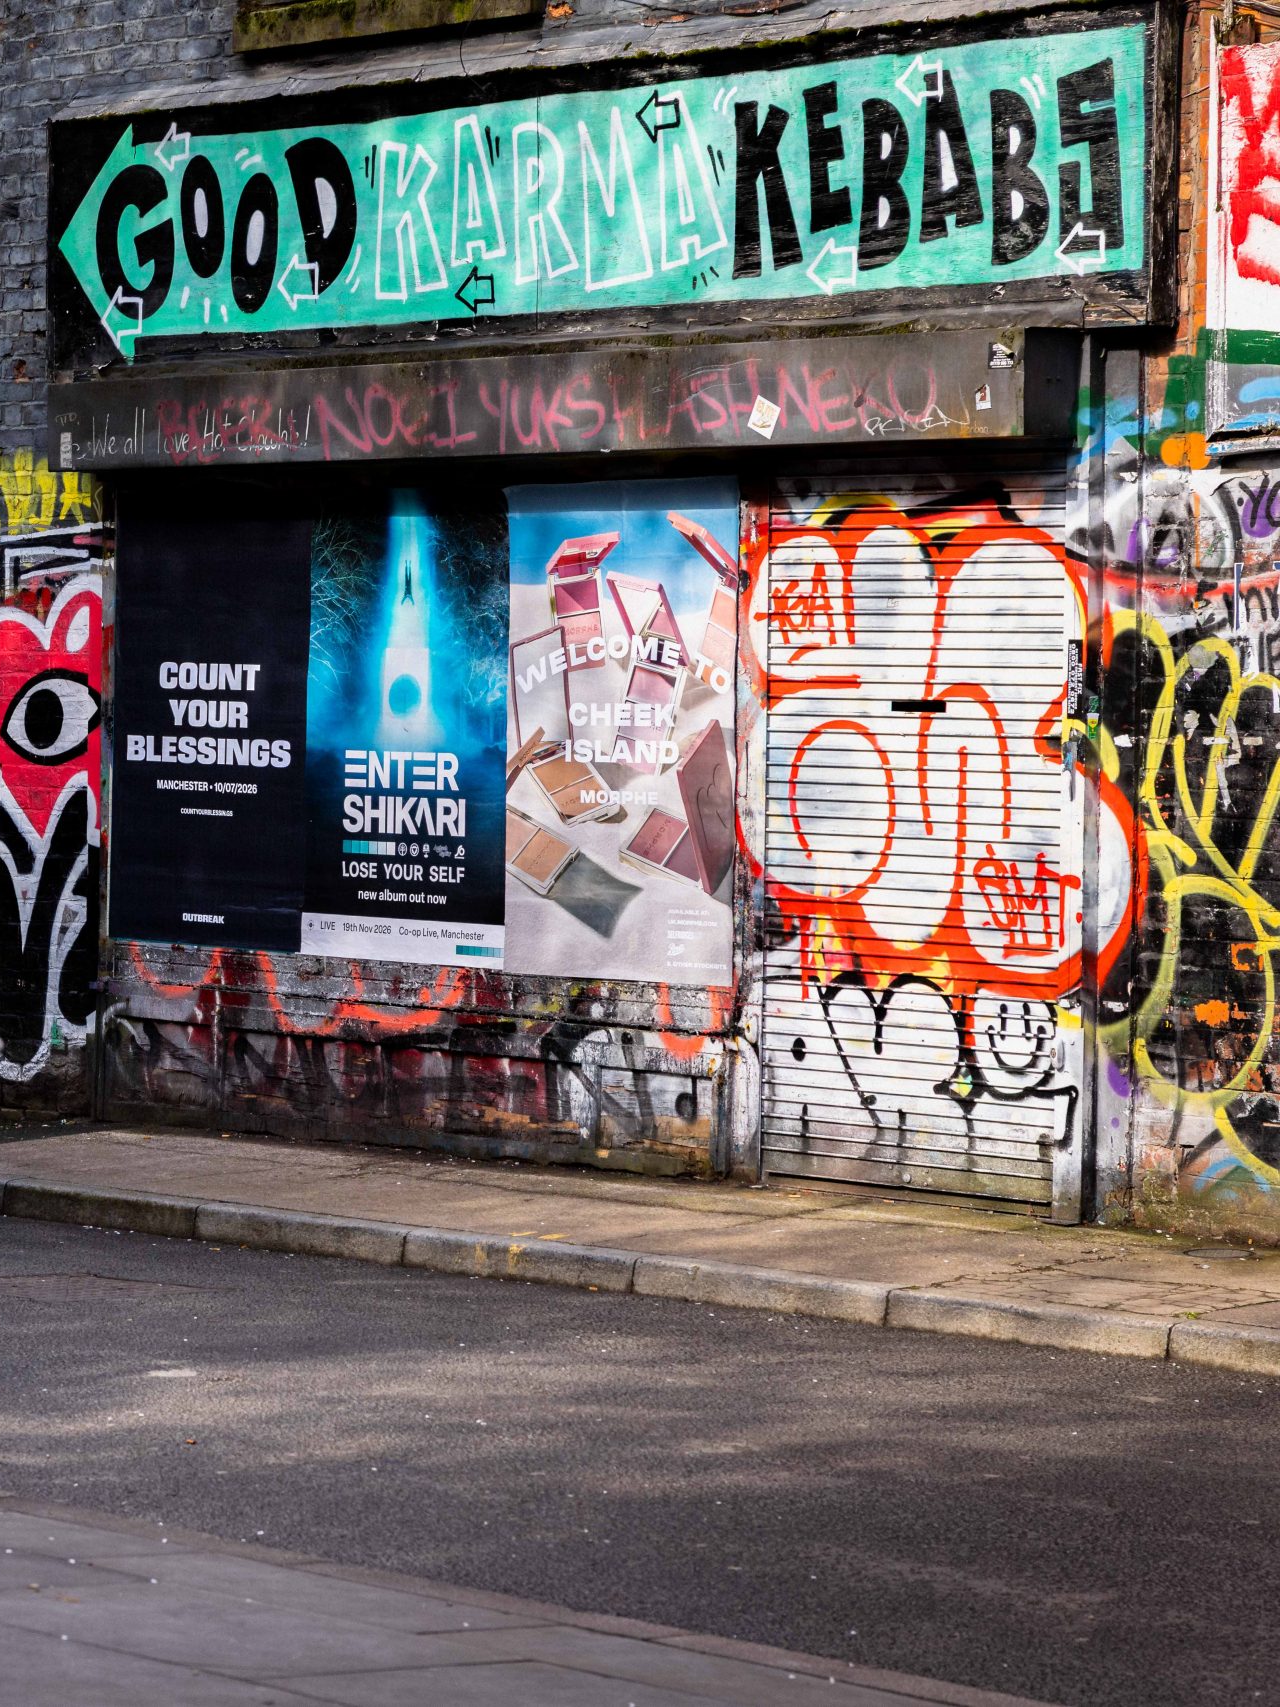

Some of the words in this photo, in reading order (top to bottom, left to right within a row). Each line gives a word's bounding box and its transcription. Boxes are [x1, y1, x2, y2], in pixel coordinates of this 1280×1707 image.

[94, 137, 358, 321] GOOD
[376, 91, 728, 302] KARMA
[732, 57, 1124, 280] KEBABS
[159, 661, 261, 691] COUNT
[515, 634, 682, 694] WELCOME
[695, 655, 731, 694] TO
[168, 699, 248, 729] YOUR
[568, 702, 675, 727] CHEEK
[126, 734, 292, 768] BLESSINGS
[564, 739, 679, 765] ISLAND
[344, 749, 460, 791] ENTER
[156, 779, 209, 792] MANCHESTER
[214, 782, 258, 795] 10/07/2026
[580, 790, 658, 806] MORPHE
[342, 794, 466, 838] SHIKARI
[342, 860, 377, 879] LOSE
[383, 863, 423, 881] YOUR
[429, 865, 465, 884] SELF
[358, 889, 377, 901] new
[378, 888, 407, 903] album
[409, 891, 425, 904] out
[427, 894, 447, 905] now
[182, 912, 224, 924] OUTBREAK
[320, 921, 336, 931] LIVE
[343, 922, 357, 932] 19th
[358, 923, 373, 933] Nov
[374, 924, 392, 935] 2026
[399, 926, 421, 938] Co-op
[422, 927, 439, 939] Live,
[441, 929, 485, 941] Manchester
